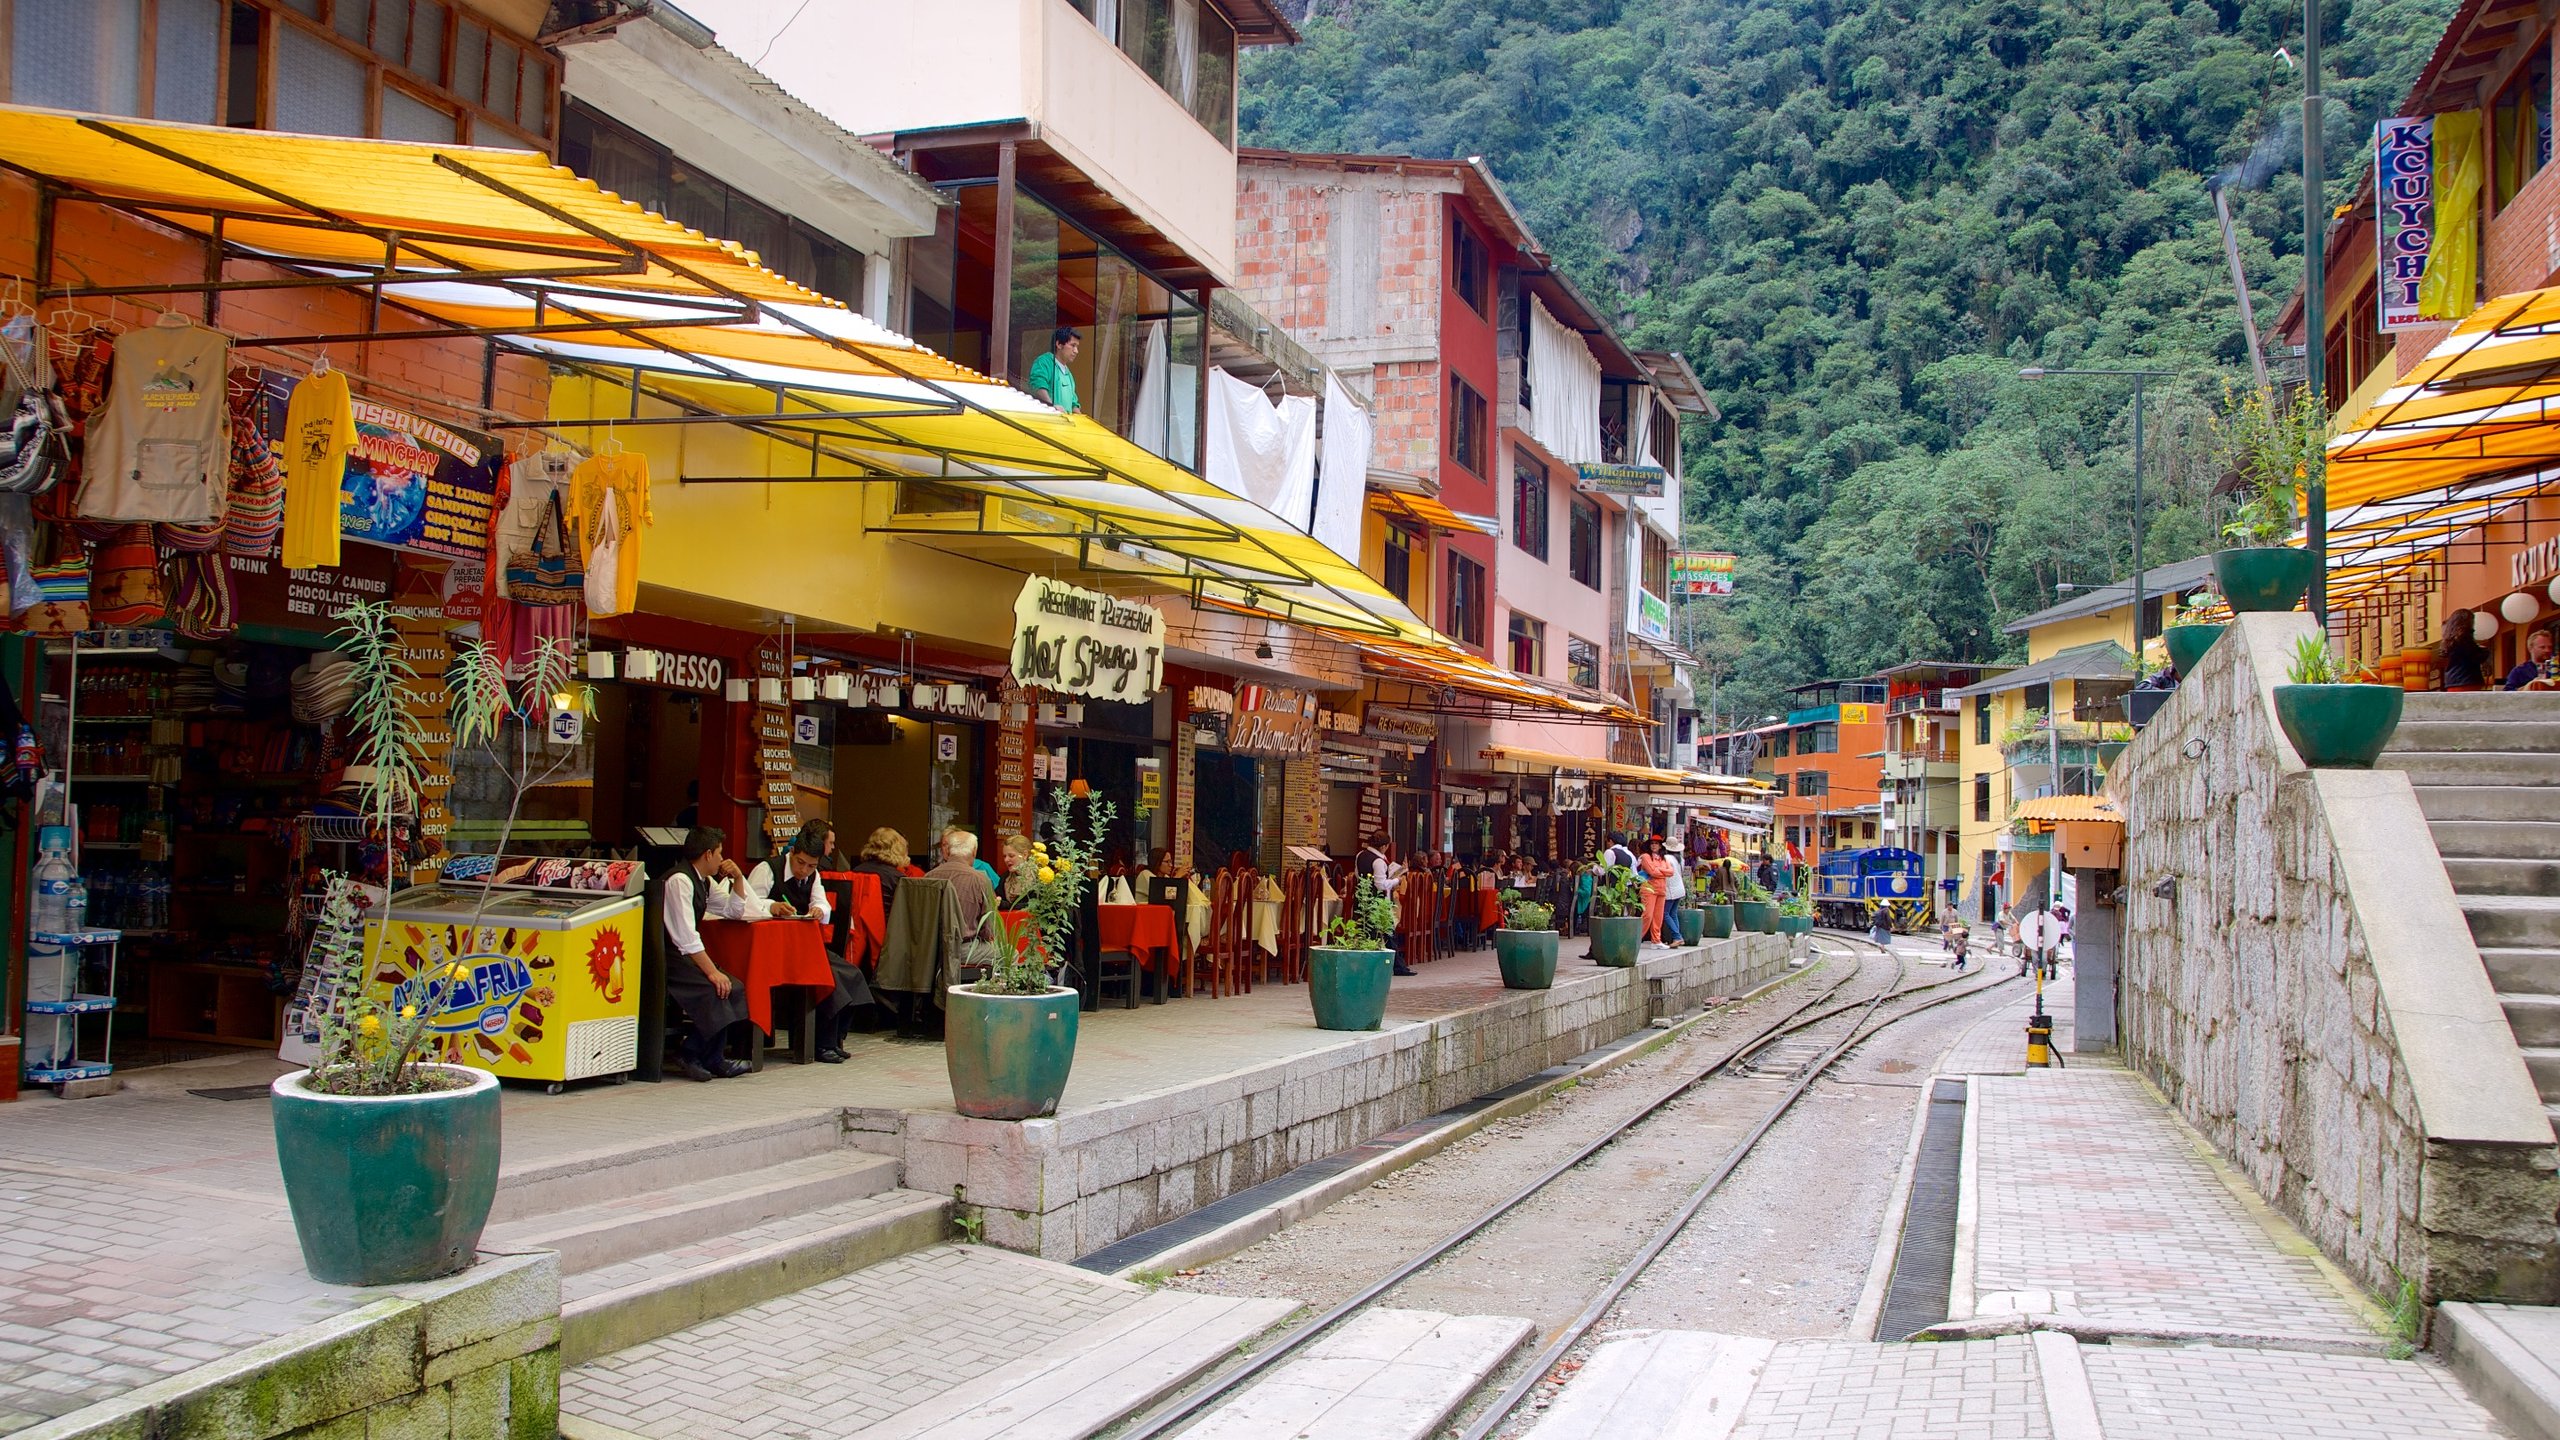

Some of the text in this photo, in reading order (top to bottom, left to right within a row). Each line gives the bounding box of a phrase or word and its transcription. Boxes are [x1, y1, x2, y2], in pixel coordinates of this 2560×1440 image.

[2391, 124, 2430, 306] KCUYCHI
[427, 480, 455, 497] BOX
[424, 525, 487, 549] HOT DRIN
[230, 556, 268, 575] DRINK
[1674, 555, 1733, 572] BUDHA
[289, 568, 331, 585] DULCES
[342, 575, 386, 594] CANDIES
[1677, 573, 1728, 582] MASSAGES
[456, 583, 481, 592] Claro
[288, 584, 360, 606] CHOCOLATES
[287, 599, 315, 616] BEER
[403, 648, 445, 660] FAJITAS
[761, 649, 773, 660] CUY
[624, 645, 722, 692] EPRESSO
[812, 667, 899, 704] AMRICANO
[403, 691, 445, 703] TACOS
[912, 681, 987, 718] CPUCCINO
[766, 714, 784, 726] PAPA
[762, 726, 789, 739] RELLENA
[763, 748, 791, 759] BROCHETA
[764, 761, 793, 771] DE ALPACA
[1004, 764, 1021, 772] PIZZA
[768, 783, 792, 793] ROCOTO
[769, 795, 795, 805] RELLENO
[1615, 795, 1626, 831] MASS
[773, 815, 798, 825] CEVICHE
[773, 828, 781, 837] DE
[474, 957, 533, 1004] FRIA
